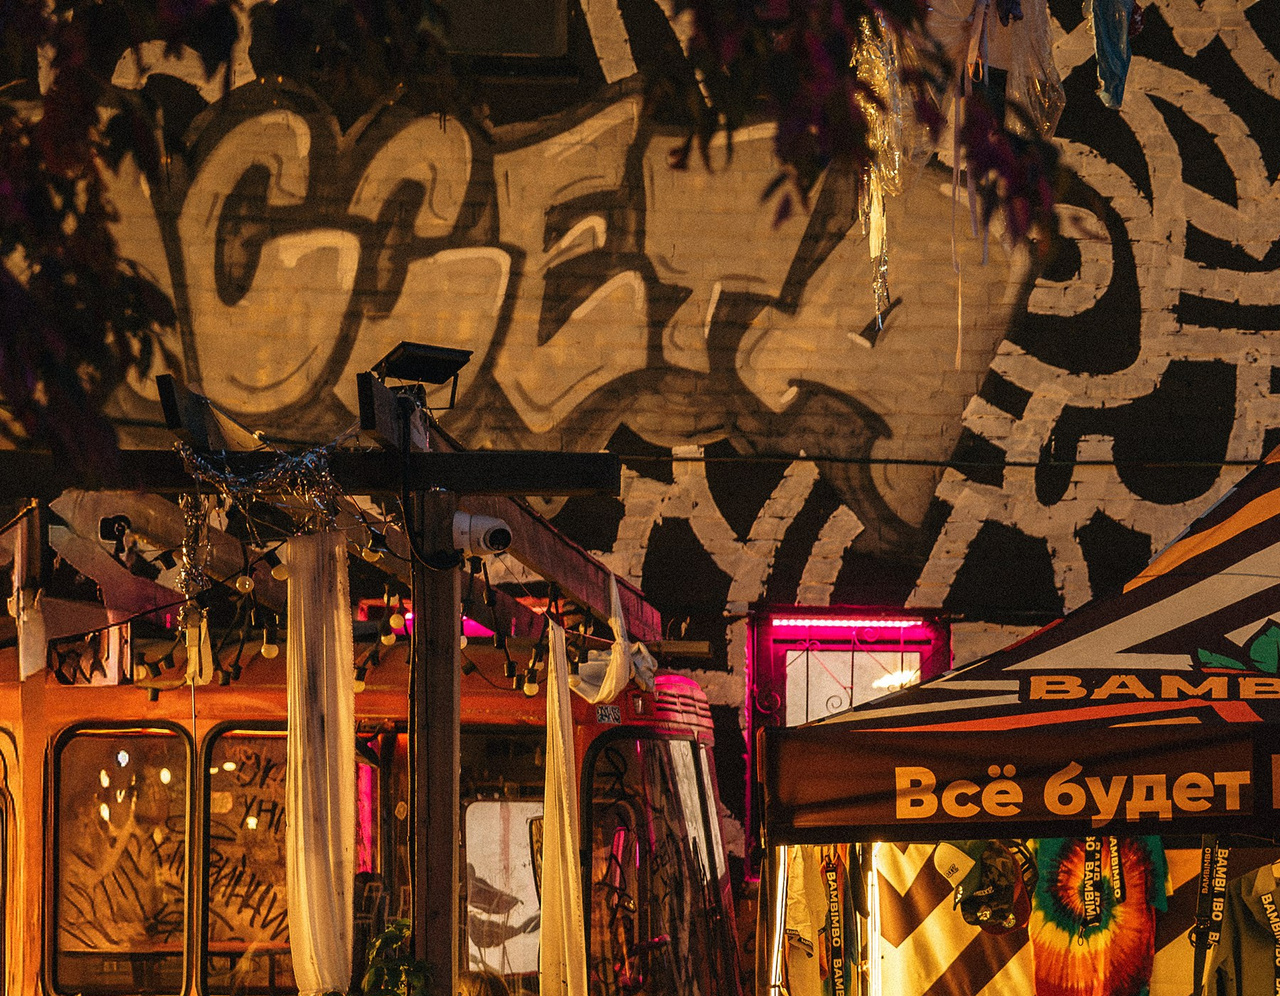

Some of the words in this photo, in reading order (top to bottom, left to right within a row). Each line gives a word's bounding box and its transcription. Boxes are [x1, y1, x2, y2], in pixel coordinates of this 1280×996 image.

[895, 764, 1024, 819] Всё
[1043, 761, 1251, 829] будет
[1109, 836, 1121, 898] AMBIMBO
[826, 871, 841, 947] BAMBIMBO
